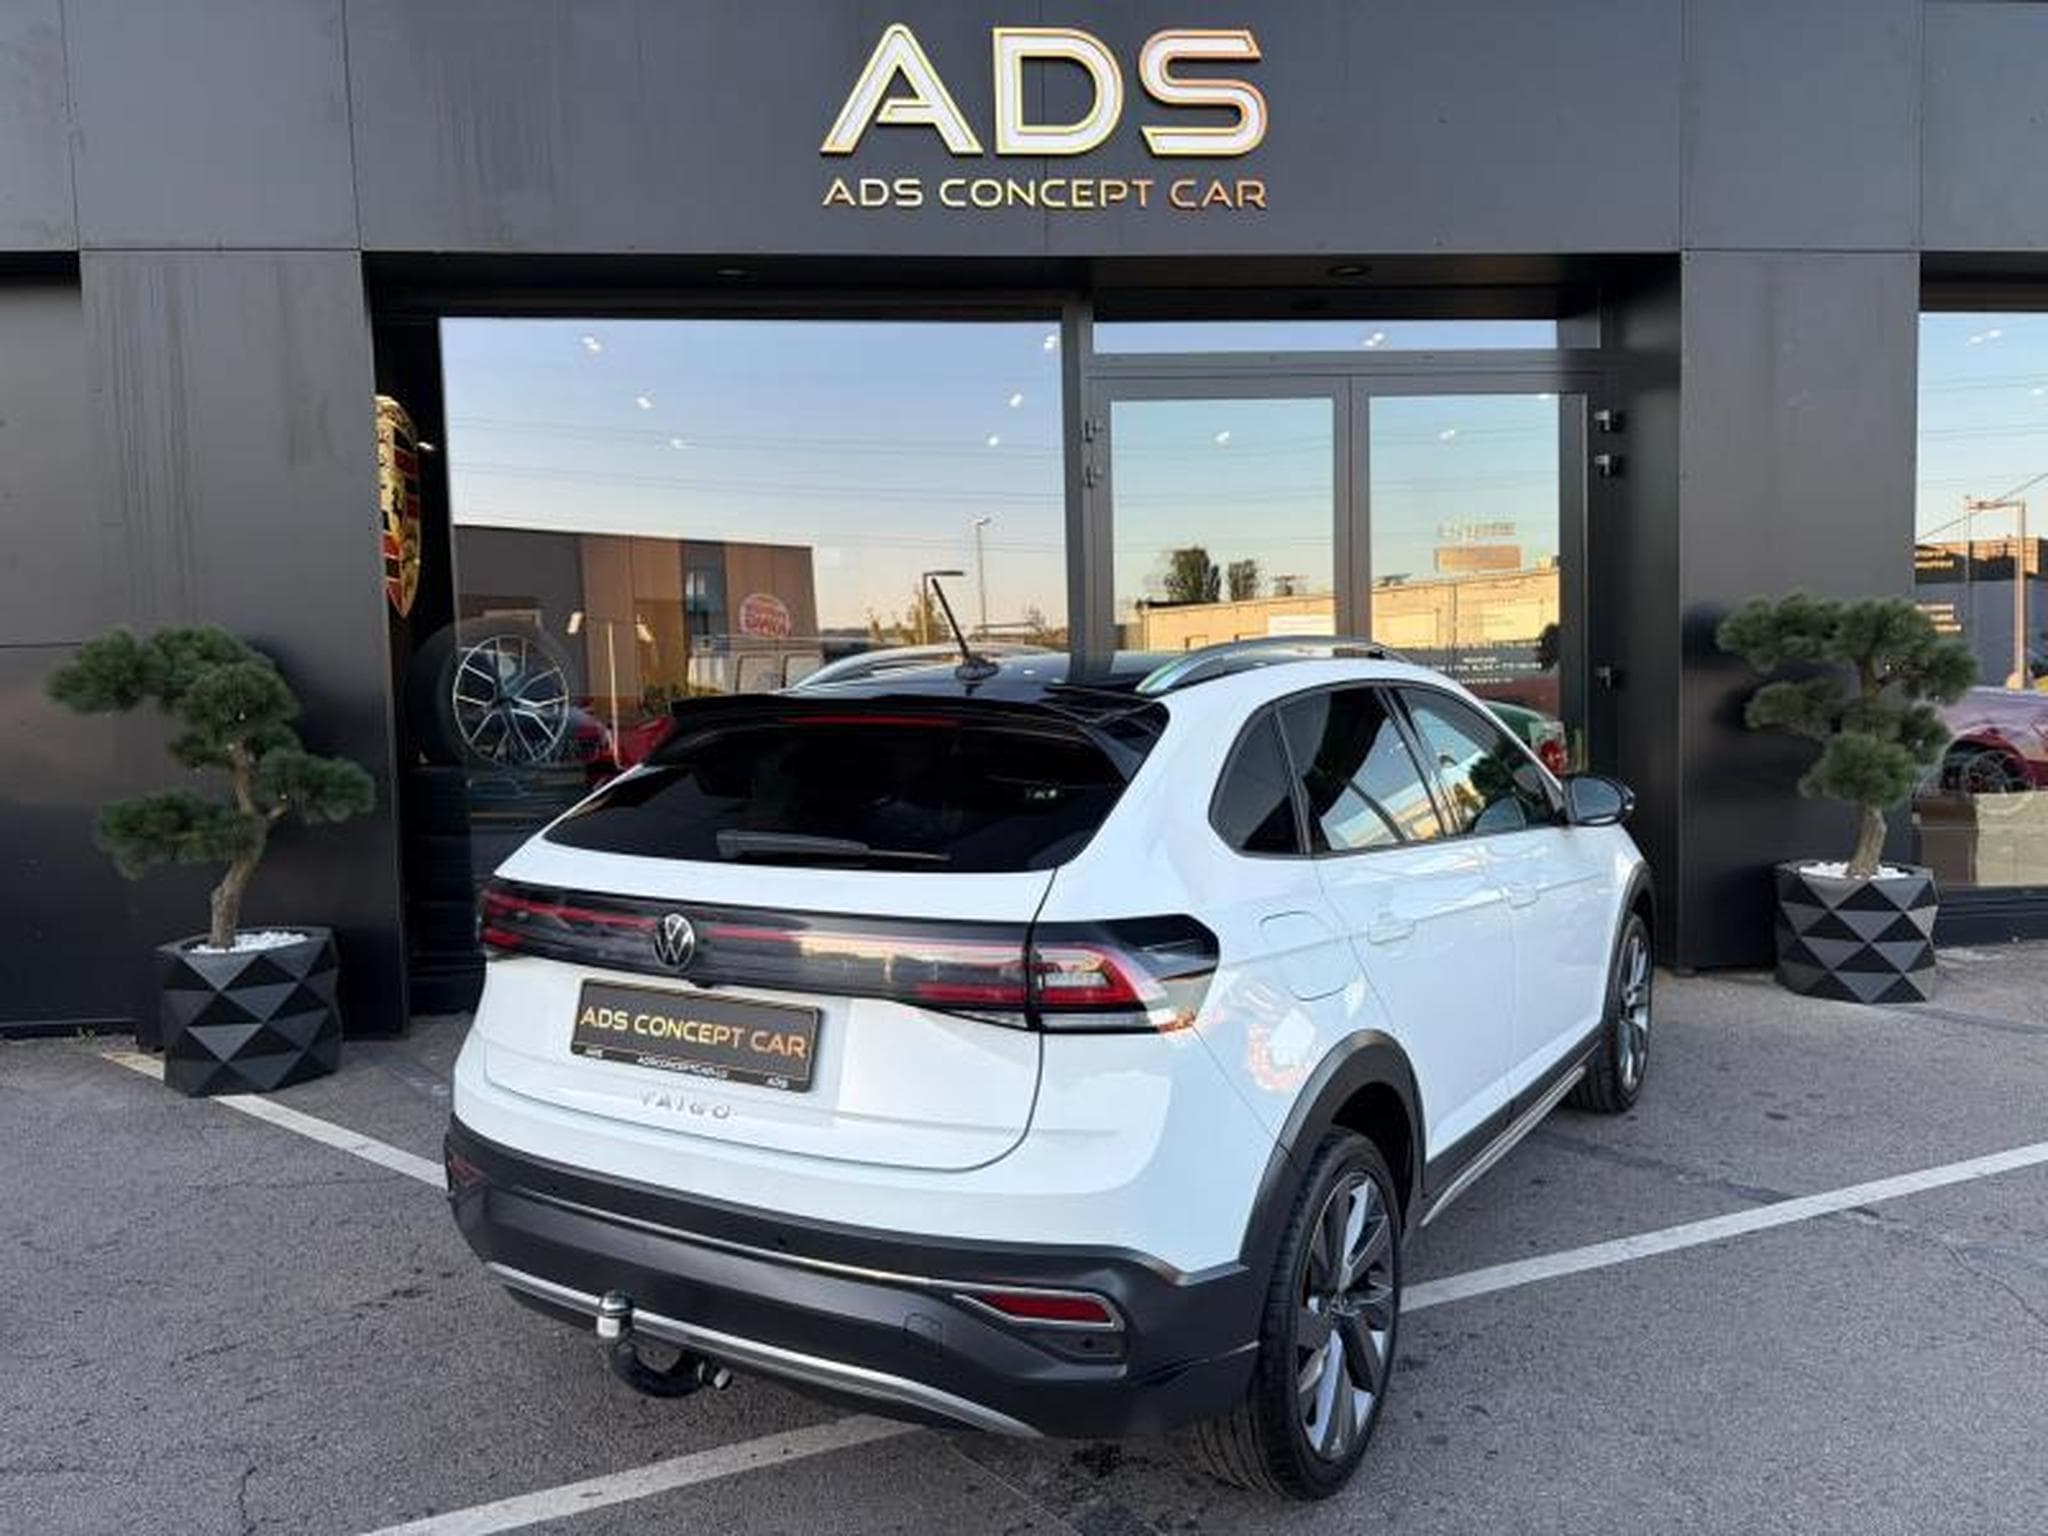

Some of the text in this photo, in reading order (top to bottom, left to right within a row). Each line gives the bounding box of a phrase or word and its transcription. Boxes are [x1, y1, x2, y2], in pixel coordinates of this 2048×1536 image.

[820, 22, 1269, 157] ADS
[822, 178, 1268, 210] ADS CONCEPT CAR
[579, 1006, 807, 1058] ADS CONCEPT CAR
